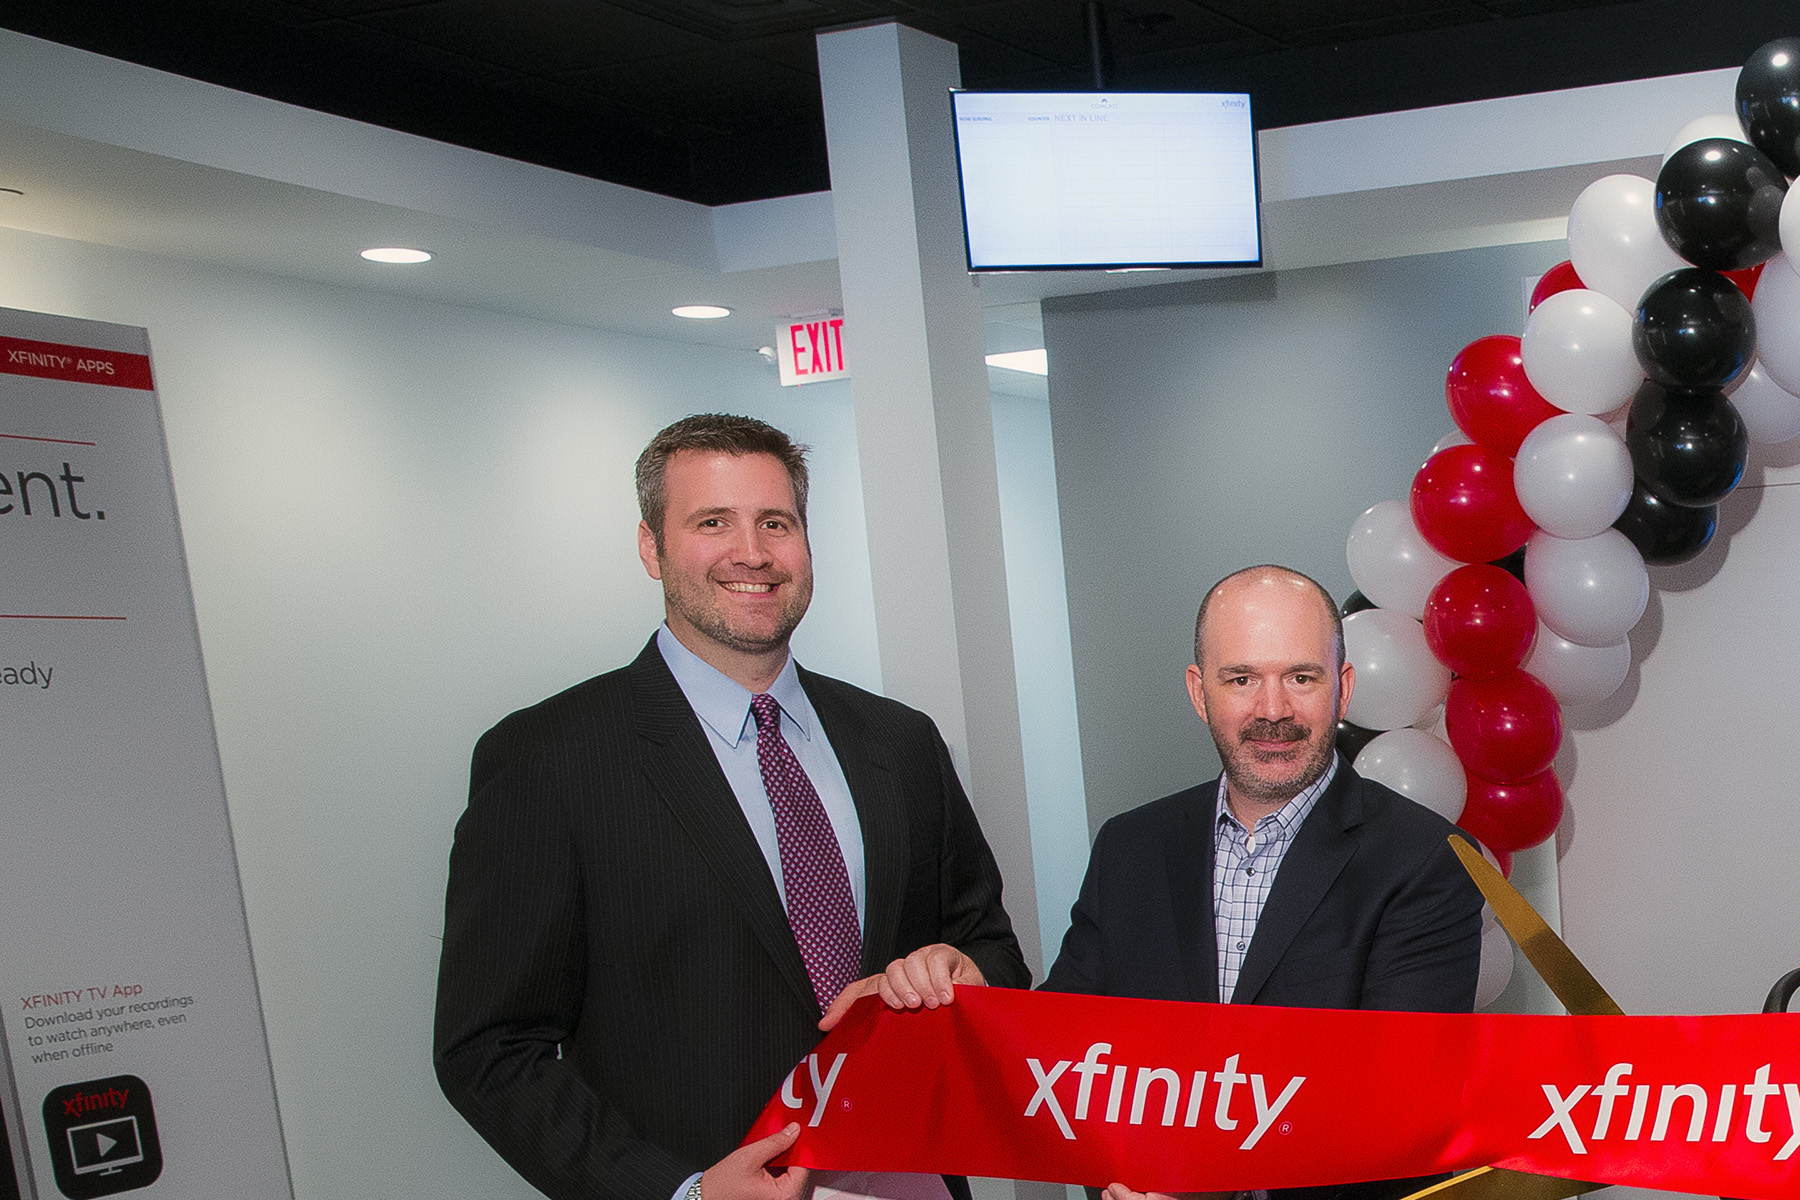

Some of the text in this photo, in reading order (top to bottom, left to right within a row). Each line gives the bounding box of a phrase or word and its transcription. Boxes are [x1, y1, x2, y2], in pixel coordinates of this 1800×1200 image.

[1054, 114, 1108, 122] NEXT IN LINE
[790, 318, 844, 376] EXIT
[76, 358, 115, 375] APPS
[0, 661, 53, 689] ady
[20, 984, 143, 1011] XFINITY TV App
[24, 994, 194, 1030] Download your recordings
[28, 1034, 43, 1047] to
[46, 1028, 87, 1044] watch
[157, 1013, 187, 1027] even
[31, 1041, 114, 1064] when offline
[62, 1087, 129, 1118] xfinity
